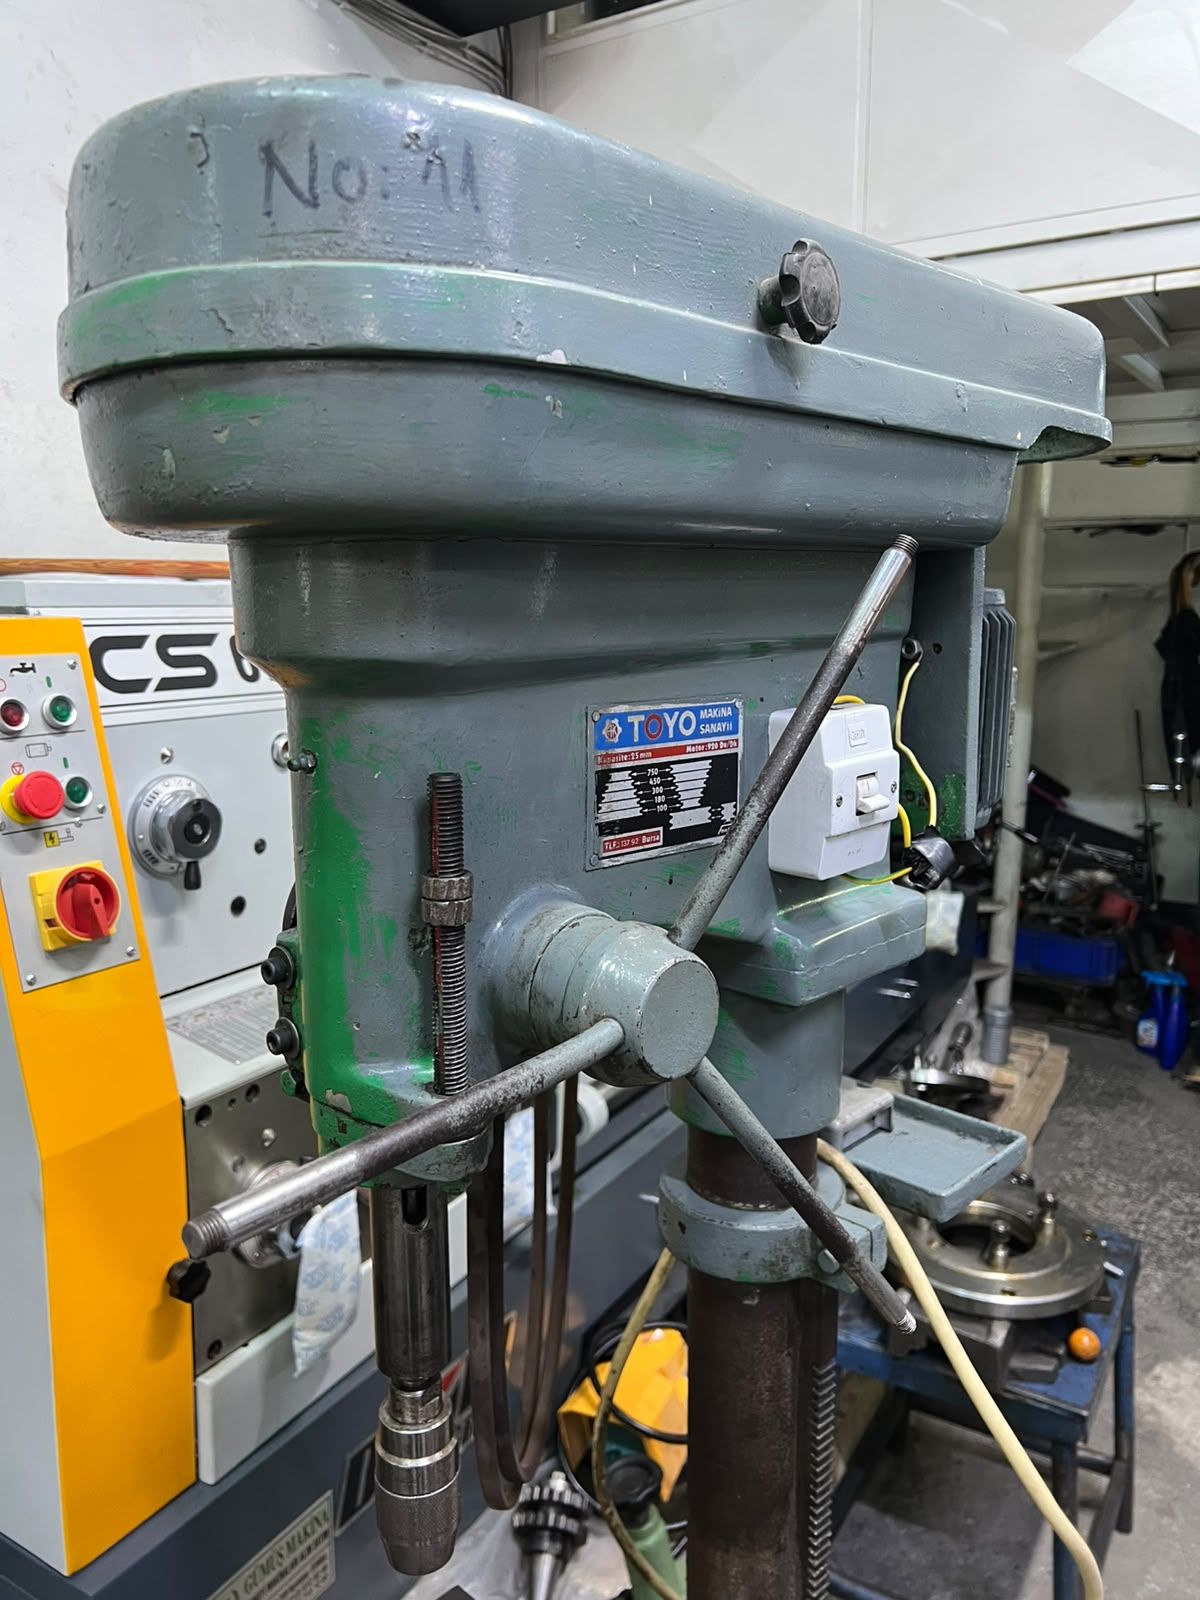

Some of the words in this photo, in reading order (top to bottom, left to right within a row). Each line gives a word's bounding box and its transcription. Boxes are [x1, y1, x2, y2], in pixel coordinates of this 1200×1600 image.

[258, 138, 391, 217] No:
[88, 632, 219, 694] CS
[627, 710, 697, 743] TOYO
[647, 768, 659, 776] 750
[649, 777, 661, 785] 450
[652, 786, 663, 795] 300
[655, 795, 666, 803] 180
[657, 804, 667, 812] 100
[641, 834, 660, 844] Bursa
